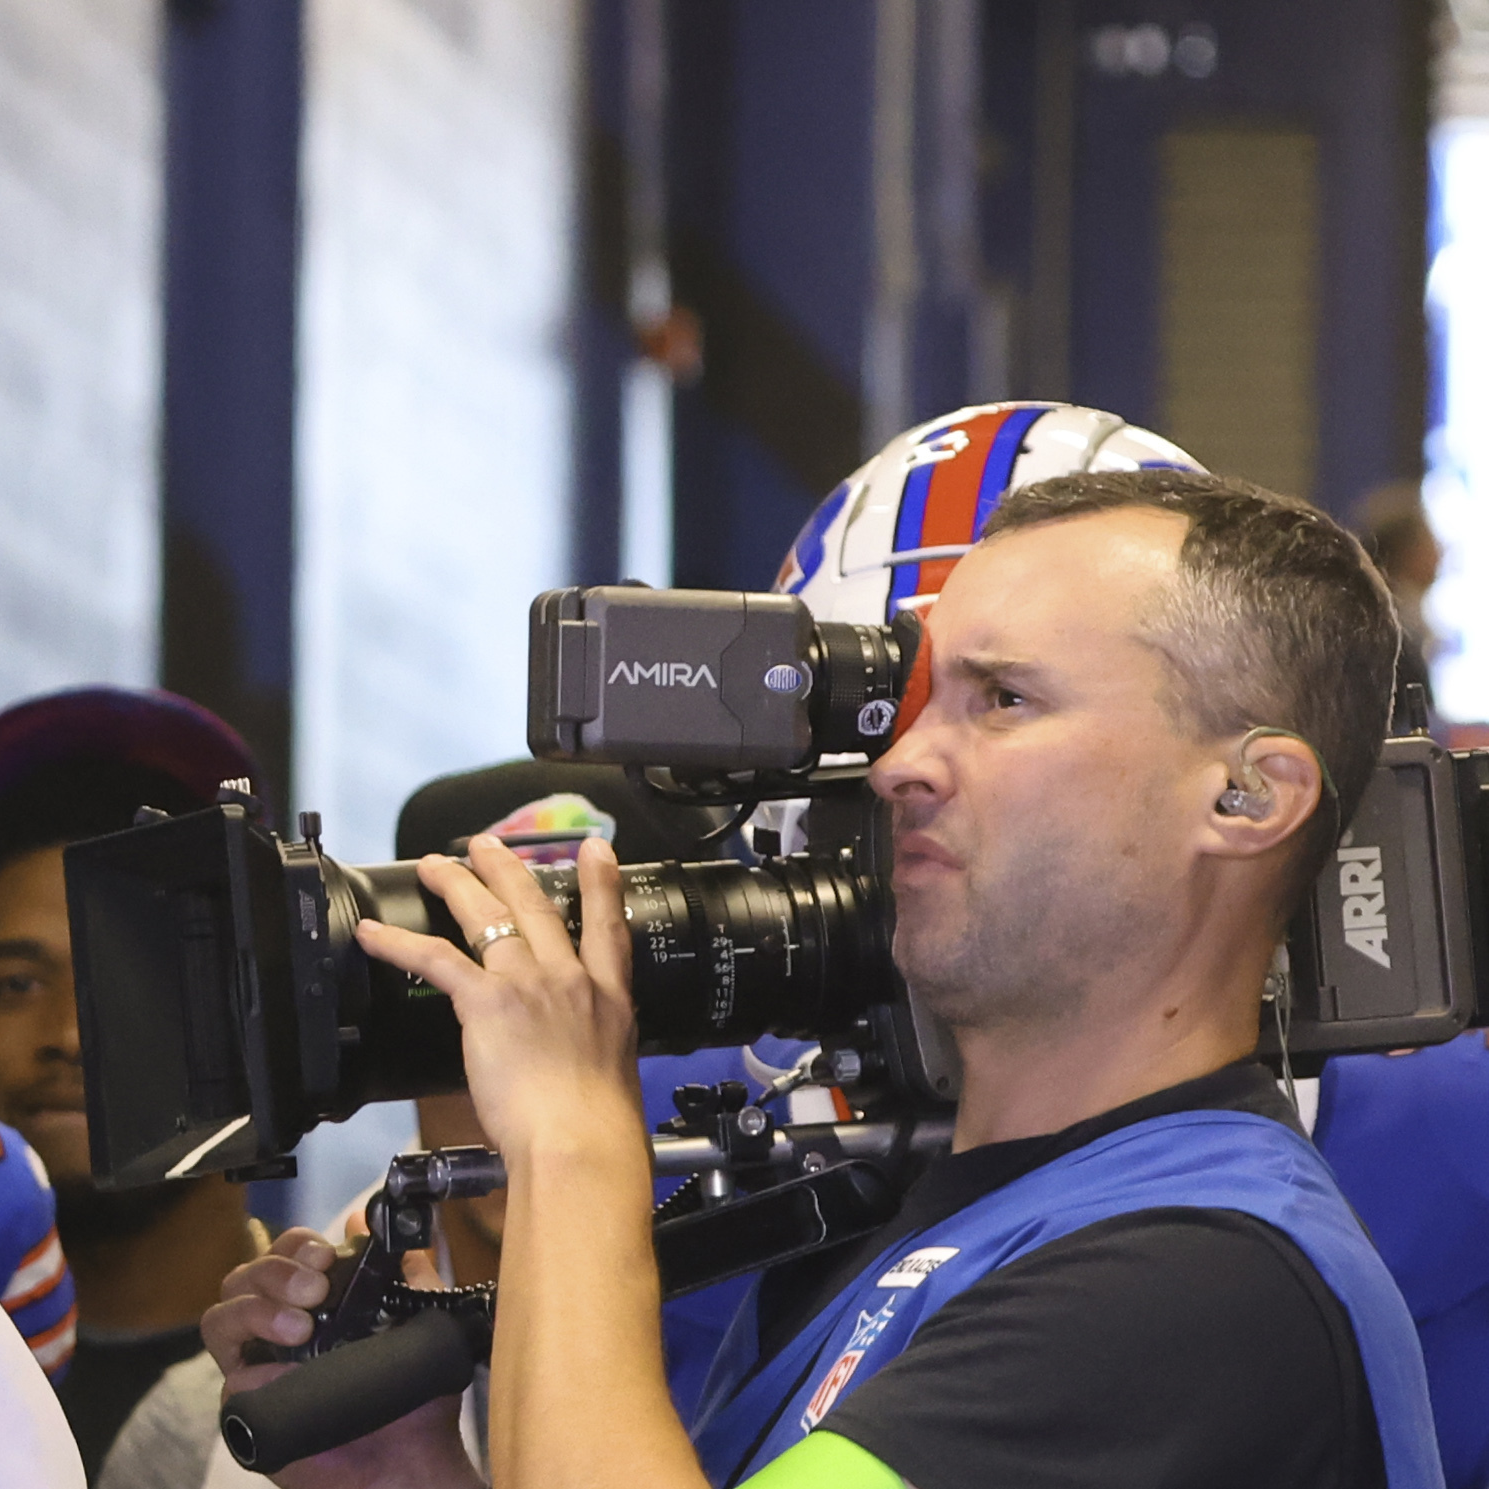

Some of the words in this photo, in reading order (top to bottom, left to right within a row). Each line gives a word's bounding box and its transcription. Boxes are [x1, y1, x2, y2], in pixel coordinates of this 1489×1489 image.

[607, 660, 718, 689] AMIRA
[1337, 846, 1391, 969] ARRI
[647, 920, 664, 933] 25
[649, 936, 666, 949] 22
[652, 951, 668, 963] 19
